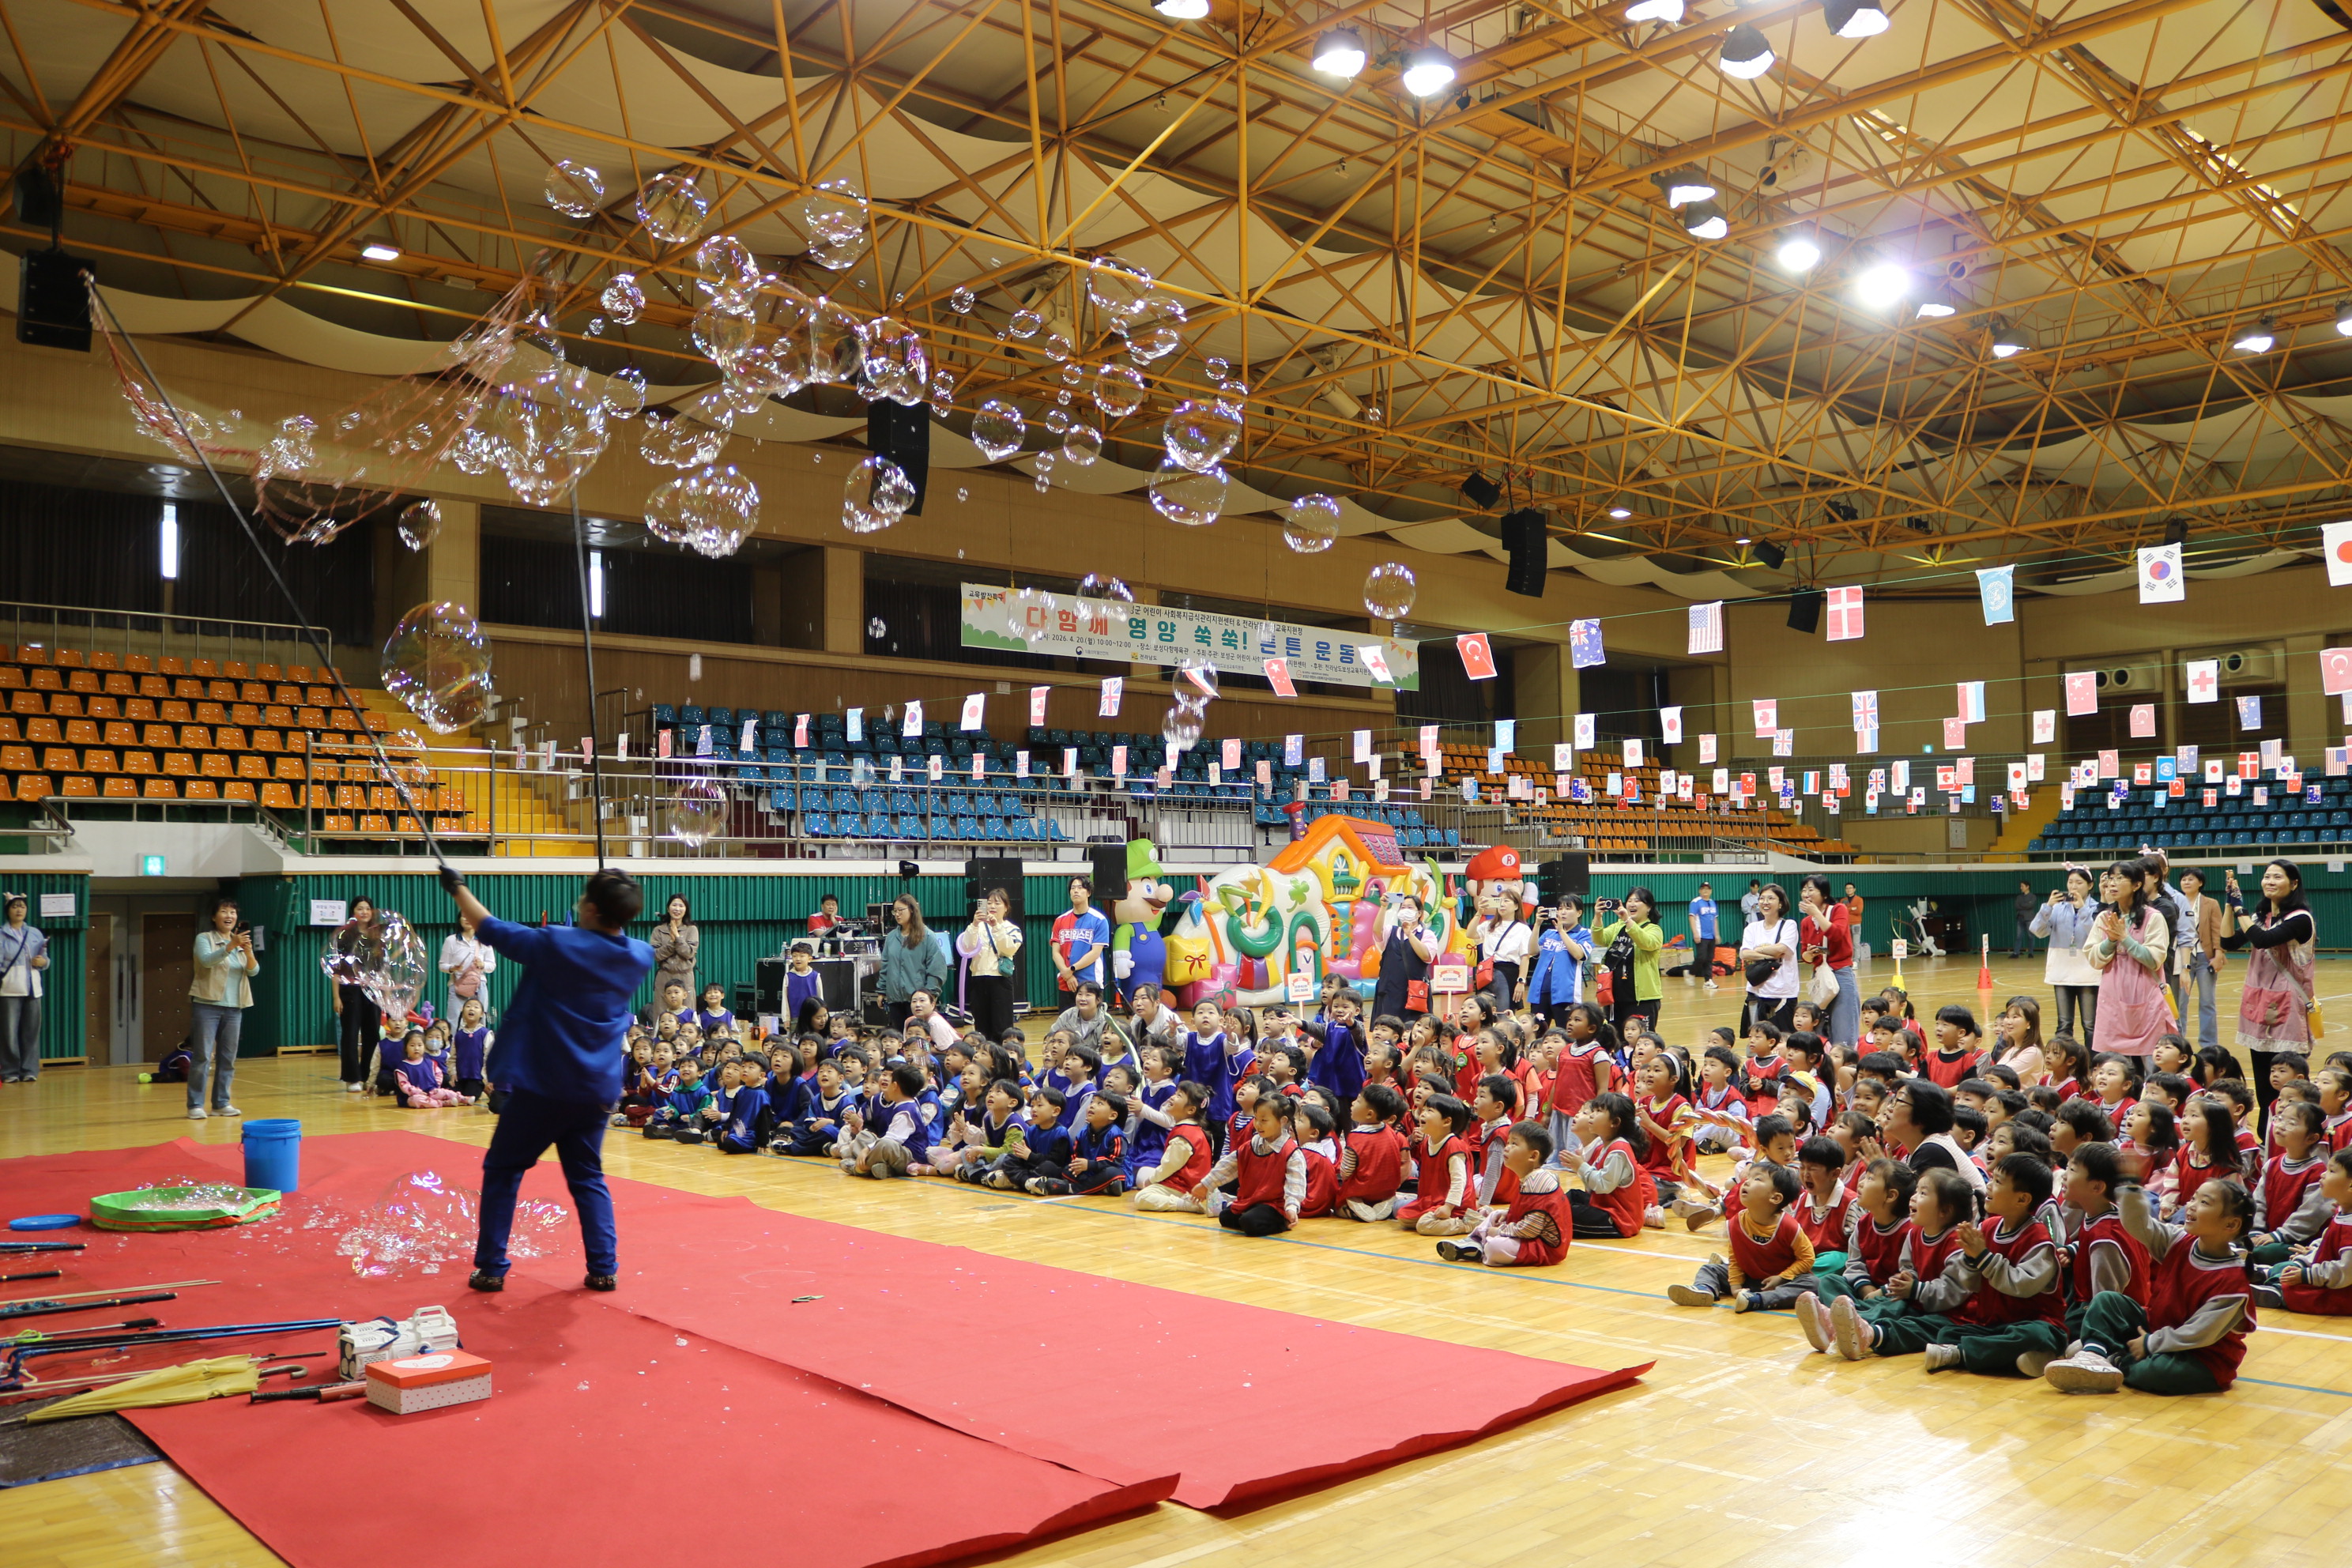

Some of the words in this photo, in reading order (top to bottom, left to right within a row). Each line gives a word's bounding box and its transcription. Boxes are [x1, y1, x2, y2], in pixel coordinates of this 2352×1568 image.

[969, 590, 1004, 601] 교육발전특구
[1097, 639, 1131, 648] 10:00~12:00
[1154, 645, 1189, 655] 보성다향체육관
